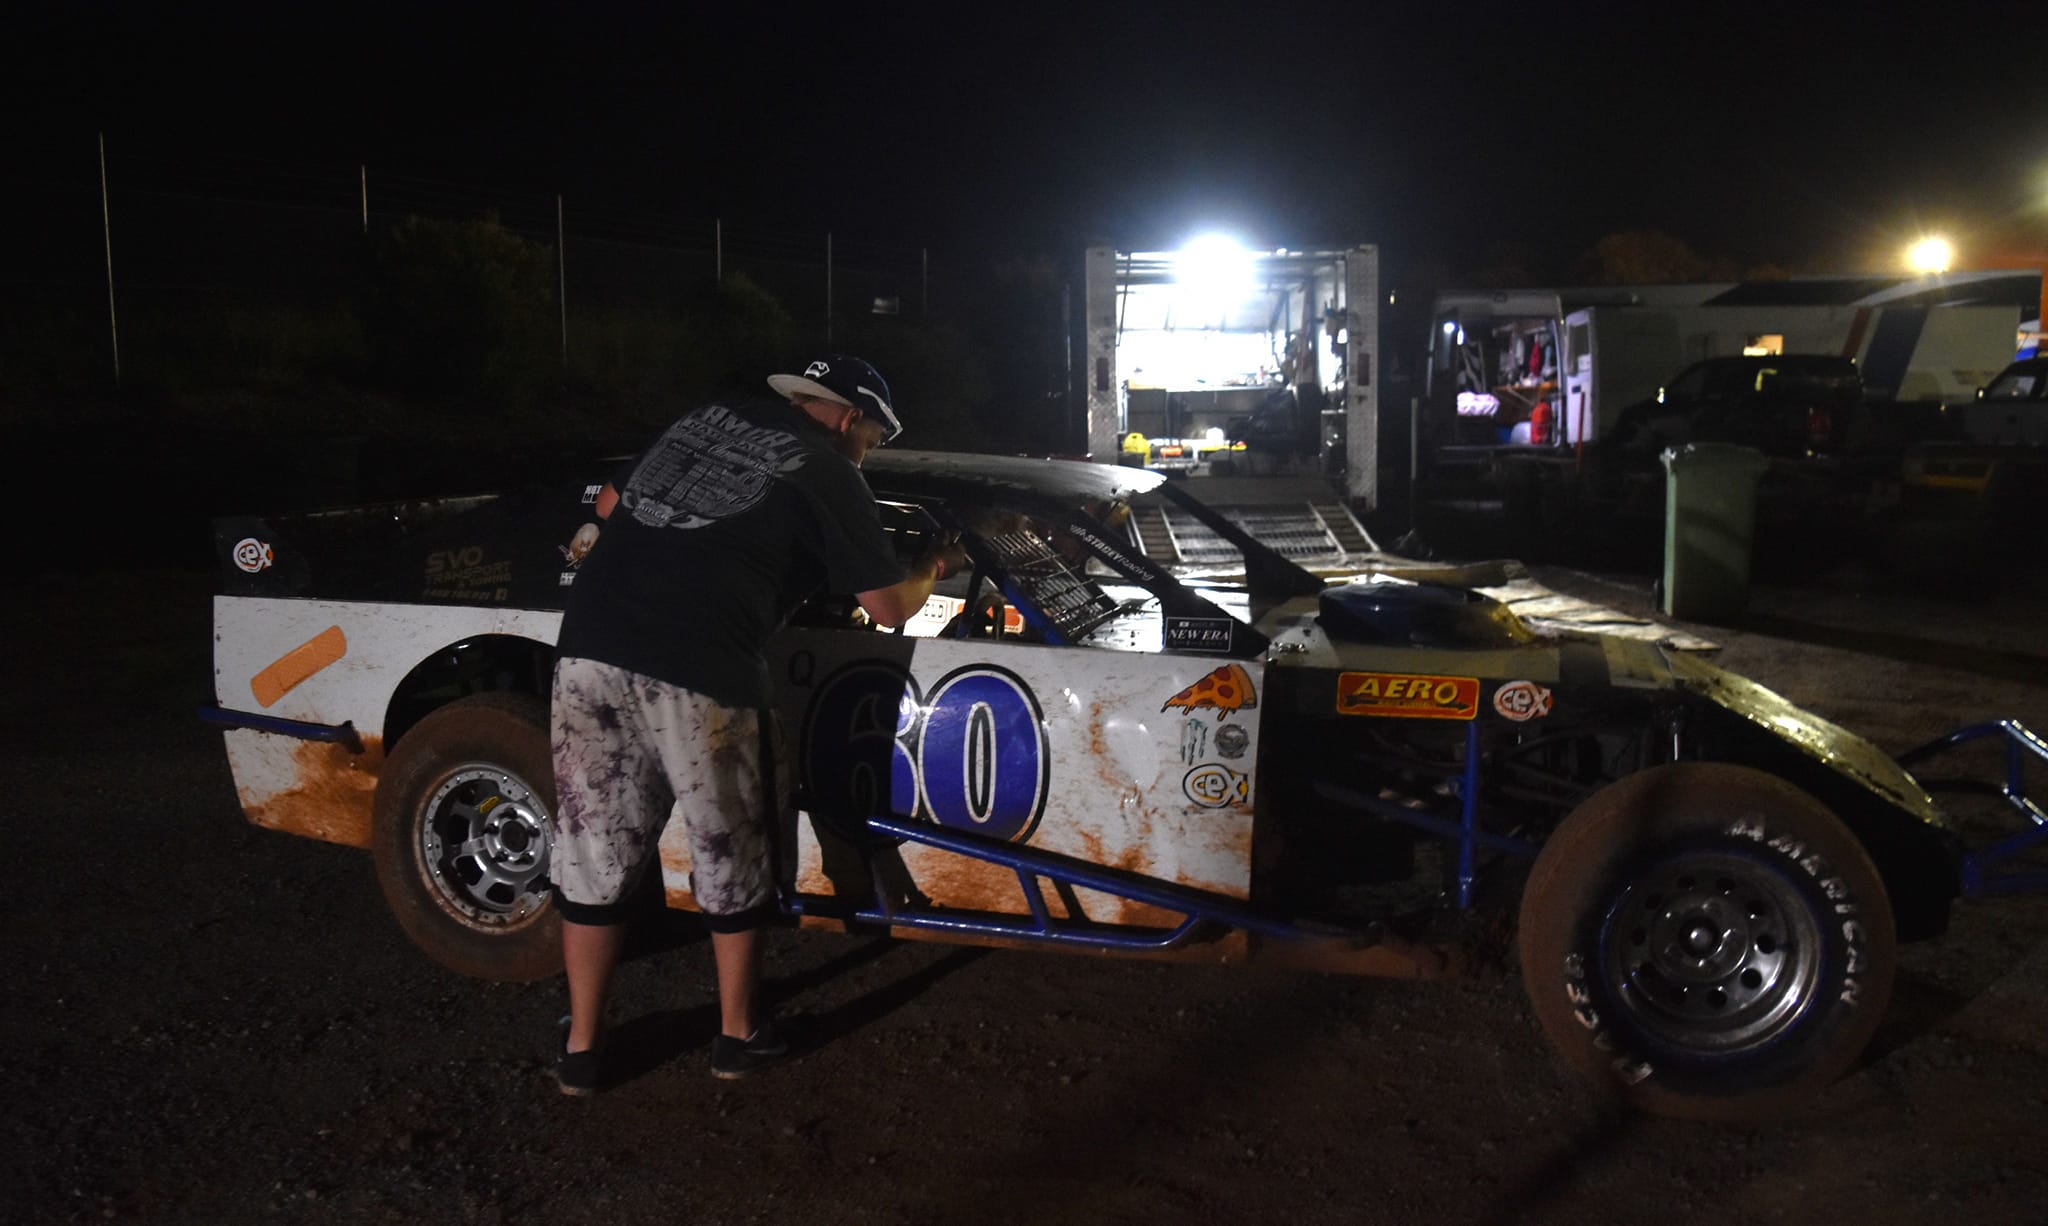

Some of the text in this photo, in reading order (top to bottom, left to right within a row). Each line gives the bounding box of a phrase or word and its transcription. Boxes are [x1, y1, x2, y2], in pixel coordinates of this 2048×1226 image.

[423, 546, 484, 575] SVO
[1168, 628, 1231, 642] NEW ERA
[788, 649, 816, 689] Q
[1353, 677, 1459, 705] AERO
[800, 658, 1051, 845] 60
